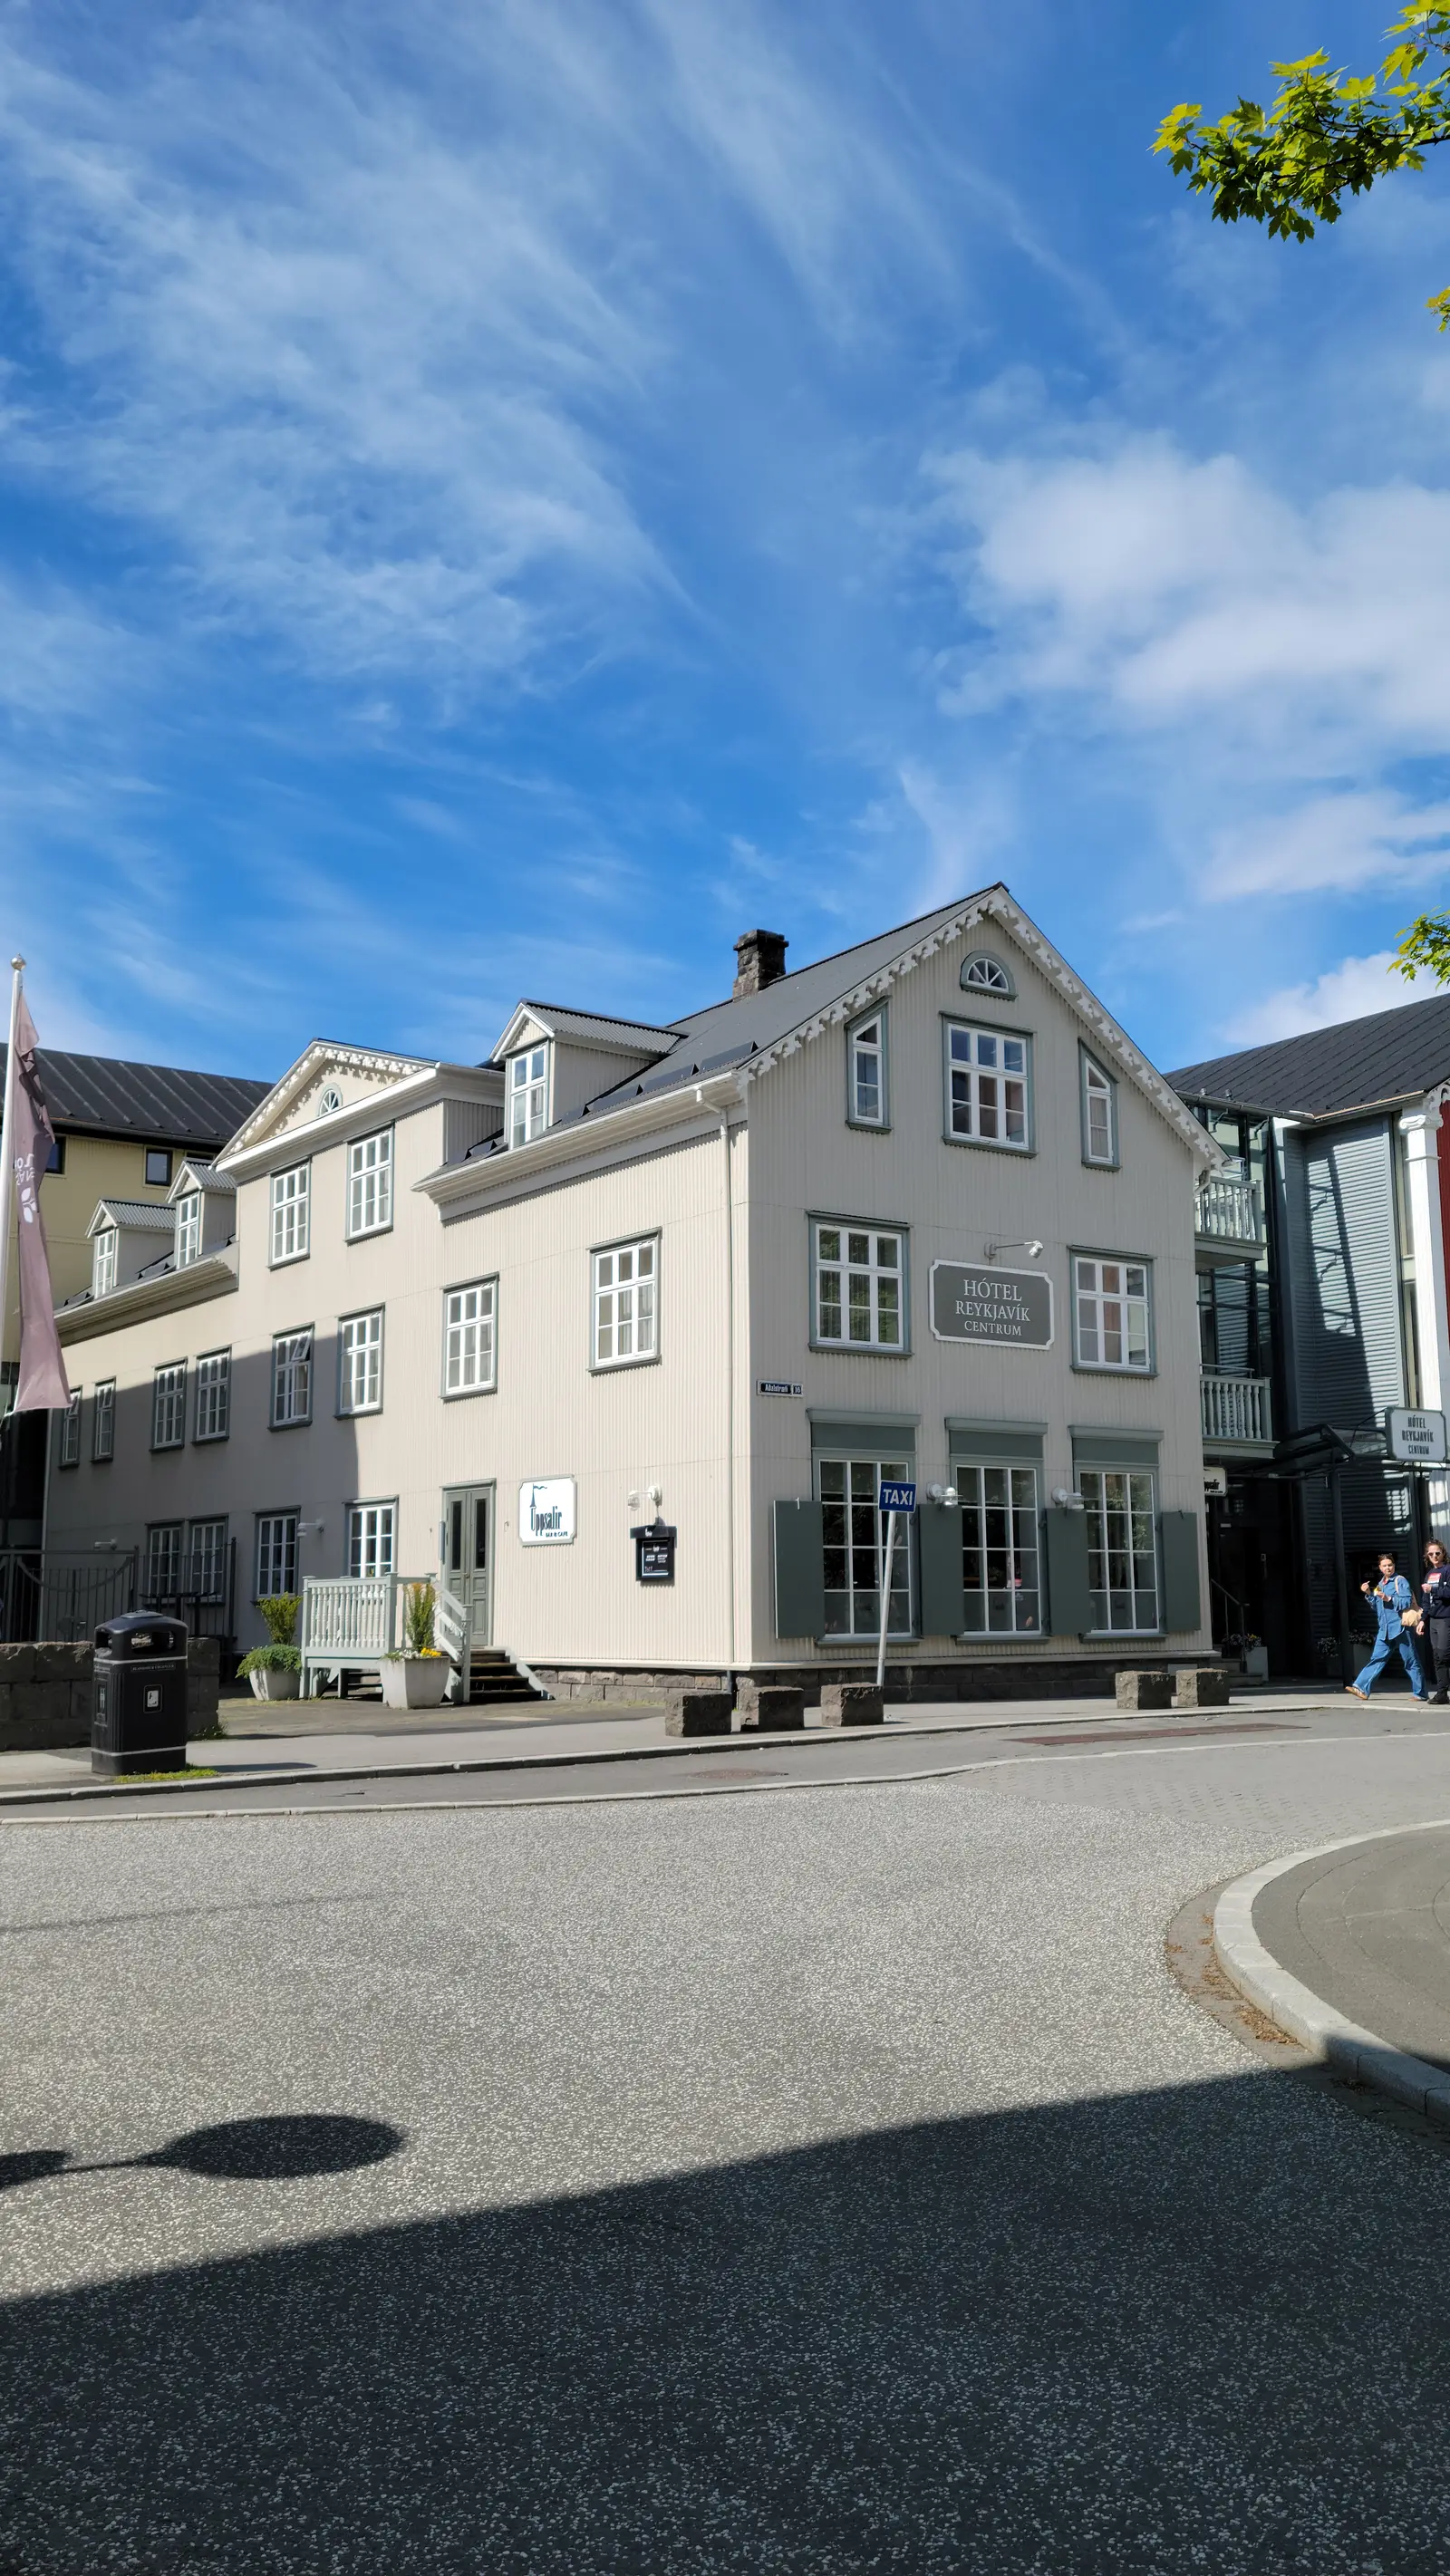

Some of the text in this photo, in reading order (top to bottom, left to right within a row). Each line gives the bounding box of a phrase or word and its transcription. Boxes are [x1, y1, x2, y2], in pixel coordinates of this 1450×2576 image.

[963, 1278, 1022, 1302] HÓTEL
[955, 1300, 1030, 1322] REYKJAVÍK
[963, 1320, 1022, 1336] CENTRUM
[1407, 1414, 1426, 1429] HÓTEL
[1401, 1429, 1434, 1442] REYKJAVÍK
[1408, 1444, 1430, 1455] CENTRUM
[883, 1489, 914, 1506] TAXI
[530, 1505, 563, 1537] Uppsalir
